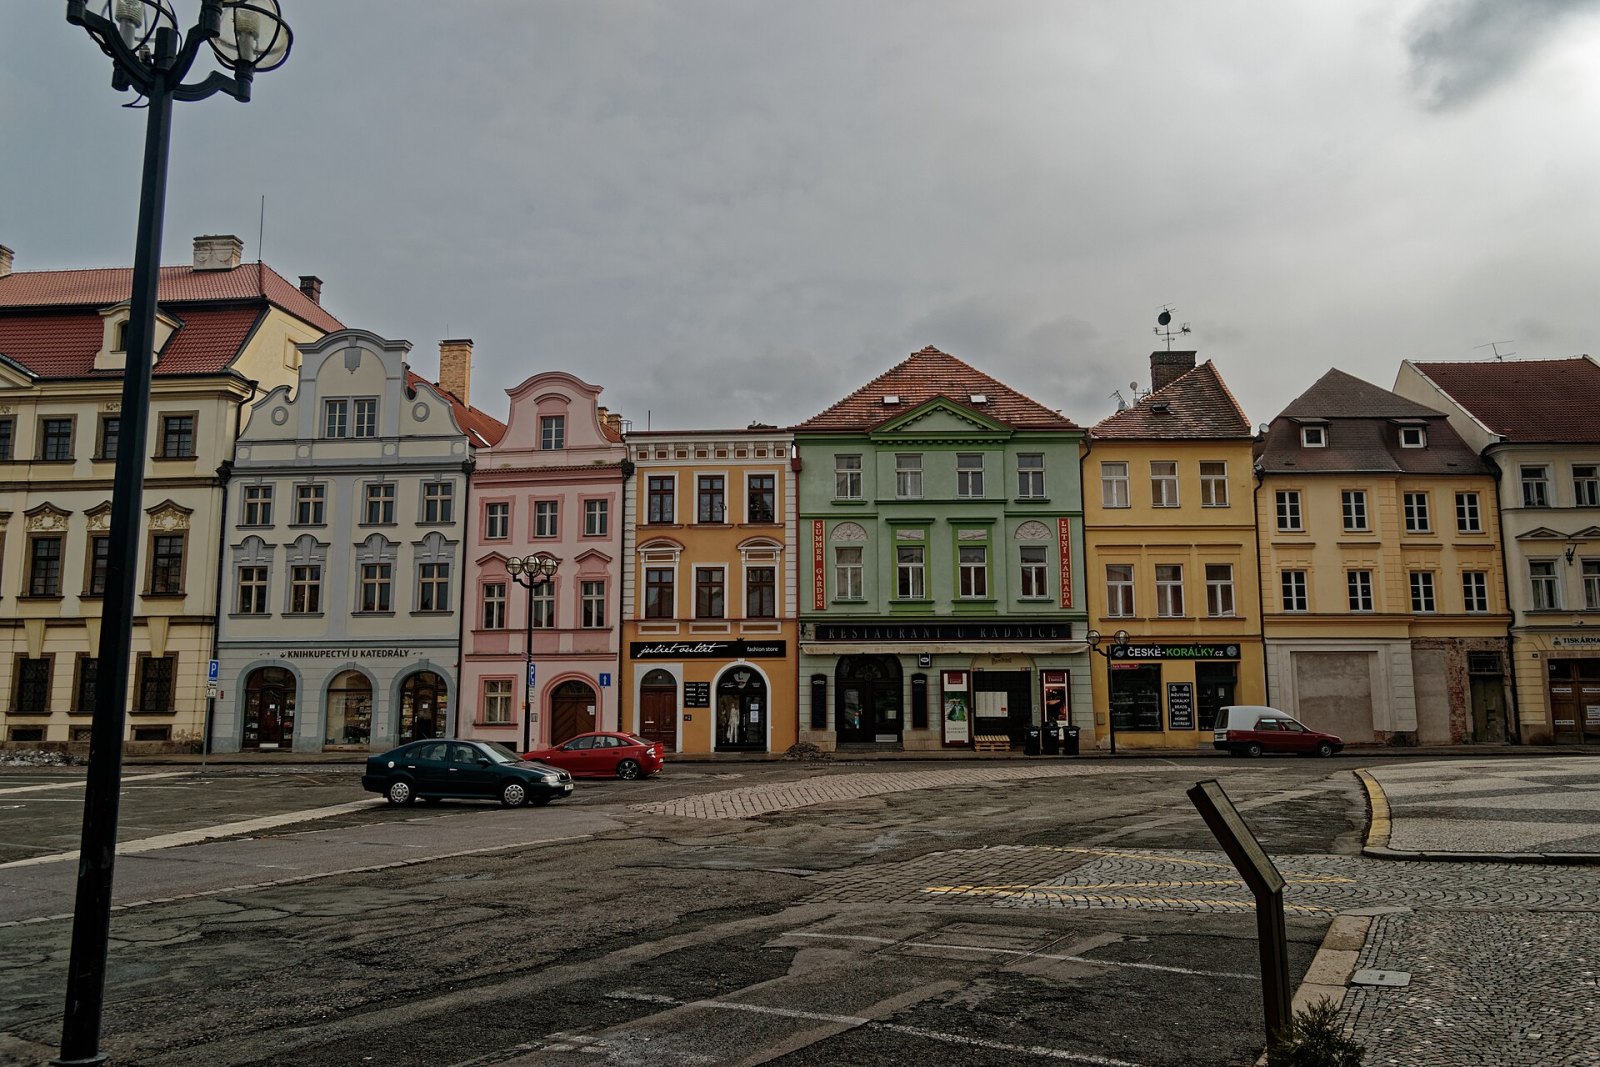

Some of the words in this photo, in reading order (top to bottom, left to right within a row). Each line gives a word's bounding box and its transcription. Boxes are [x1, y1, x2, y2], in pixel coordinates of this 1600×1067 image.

[814, 522, 822, 560] SUMMER
[816, 568, 824, 606] GARDEN
[1062, 558, 1070, 605] ZAHRADA
[828, 626, 942, 639] RESTAURANT
[957, 626, 965, 638] U
[980, 626, 1058, 638] RADNICE
[287, 648, 350, 658] KNIHKUPECTVÍ
[352, 650, 358, 658] U
[360, 648, 410, 658] KATEDRÁLY
[636, 642, 681, 658] juliet
[679, 642, 728, 653] outlet
[211, 662, 217, 675] P
